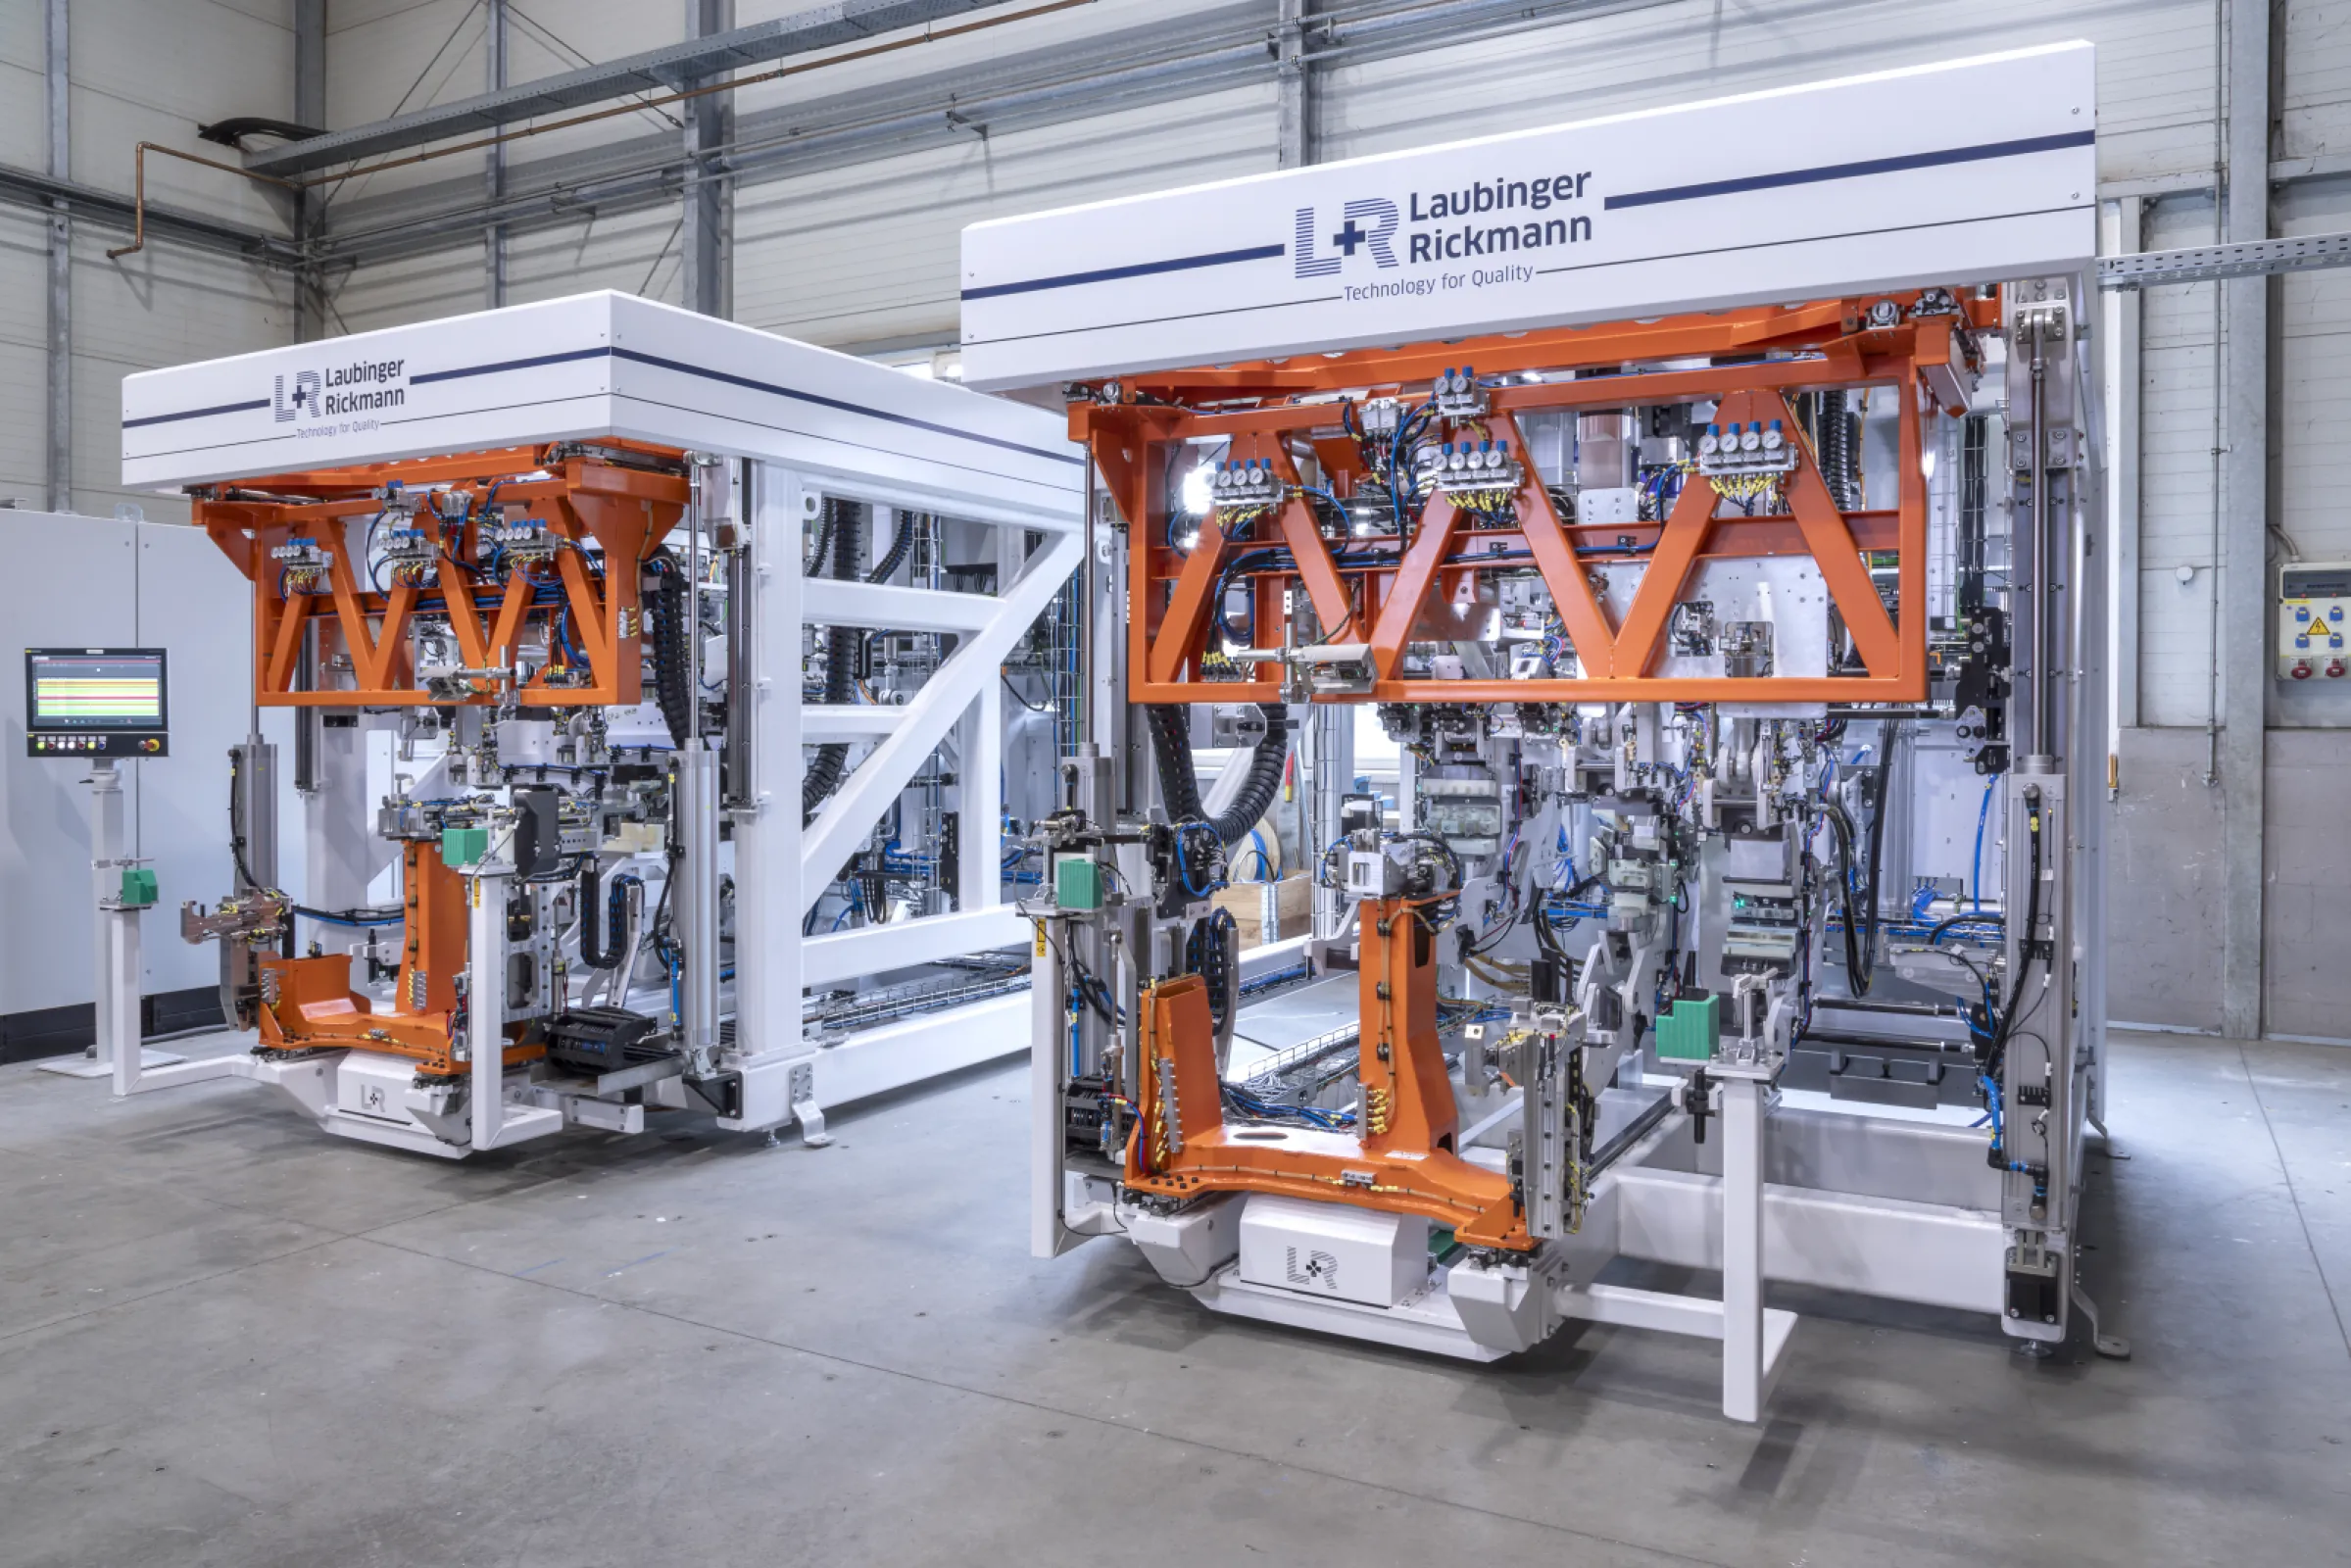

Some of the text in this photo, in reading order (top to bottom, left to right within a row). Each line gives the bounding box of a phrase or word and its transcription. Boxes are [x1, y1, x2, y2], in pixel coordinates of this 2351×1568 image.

[1409, 171, 1592, 222] Laubinger
[1409, 215, 1592, 264] Rickmann
[1344, 265, 1534, 302] Technology for Quality
[325, 359, 405, 388] Laubinger
[325, 387, 405, 416] Rickmann
[297, 417, 379, 439] Technology for Quality
